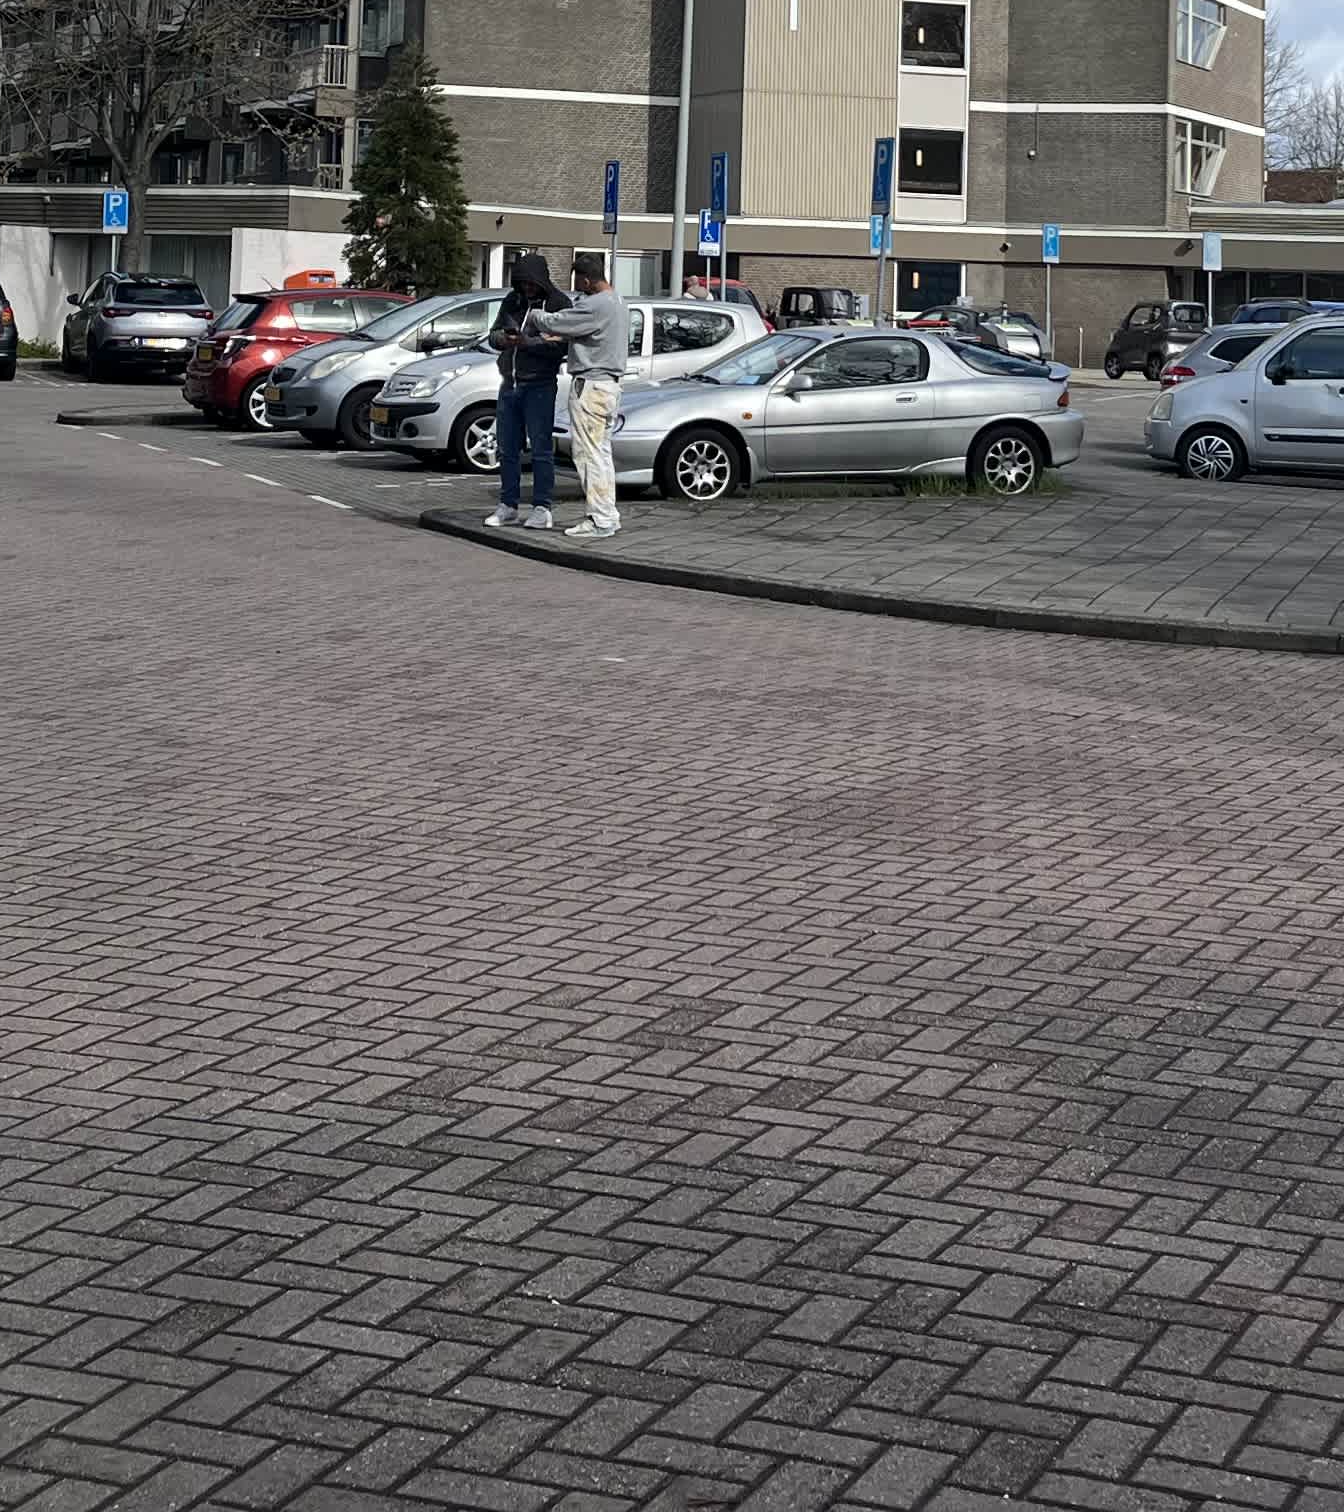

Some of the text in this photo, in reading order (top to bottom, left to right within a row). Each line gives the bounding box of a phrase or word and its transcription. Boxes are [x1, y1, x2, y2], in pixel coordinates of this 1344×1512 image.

[607, 165, 614, 192] P
[109, 194, 122, 212] P
[1047, 227, 1055, 243] P
